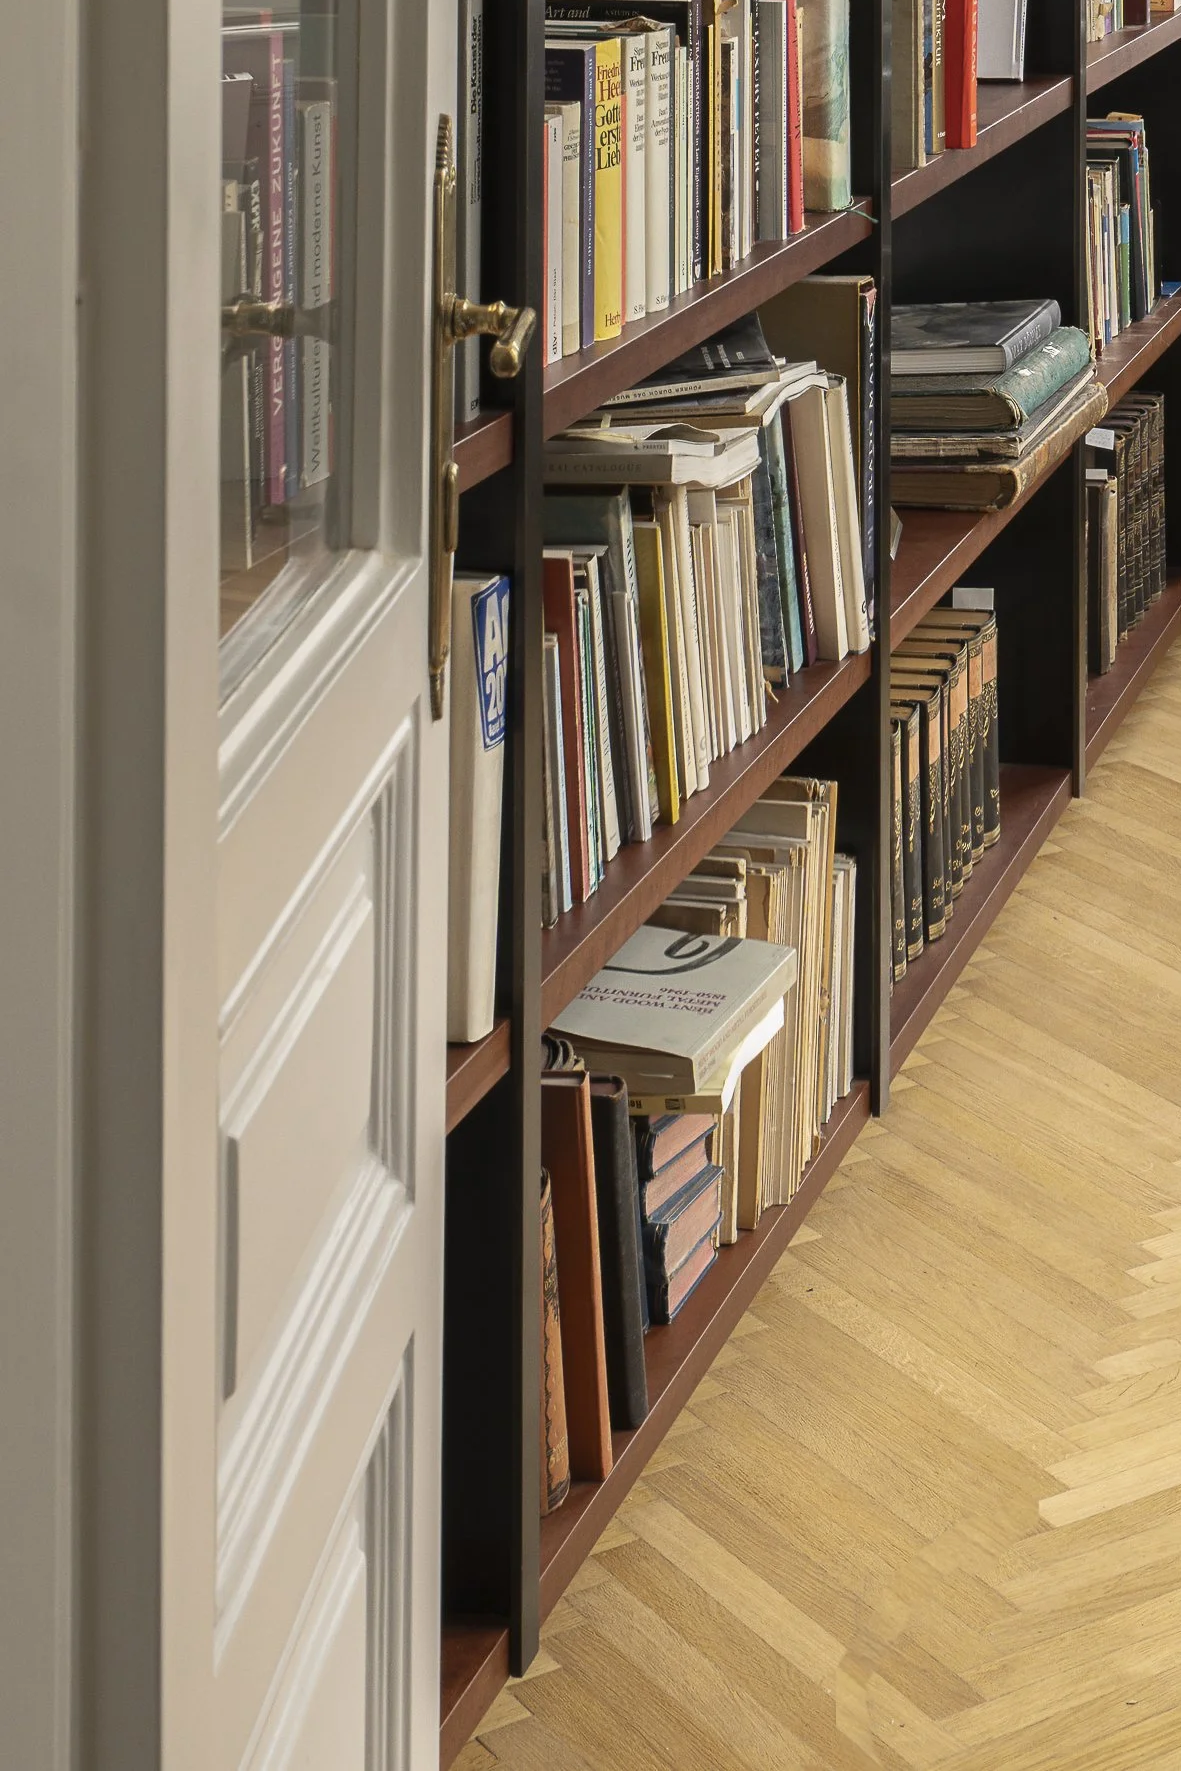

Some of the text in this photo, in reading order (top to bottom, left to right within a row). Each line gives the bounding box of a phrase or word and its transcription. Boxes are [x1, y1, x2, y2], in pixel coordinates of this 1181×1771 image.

[312, 114, 322, 177] Kunst
[271, 54, 283, 416] VERGNGENE ZUKUNFT
[312, 184, 322, 278] moderne
[311, 334, 323, 472] Weltkulture
[648, 386, 672, 397] DURCH
[573, 462, 642, 473] CATALOGUE
[598, 656, 610, 756] BELVEDERE
[612, 997, 665, 1009] WOOD
[663, 995, 721, 1007] METAL
[669, 1003, 714, 1015] BENT
